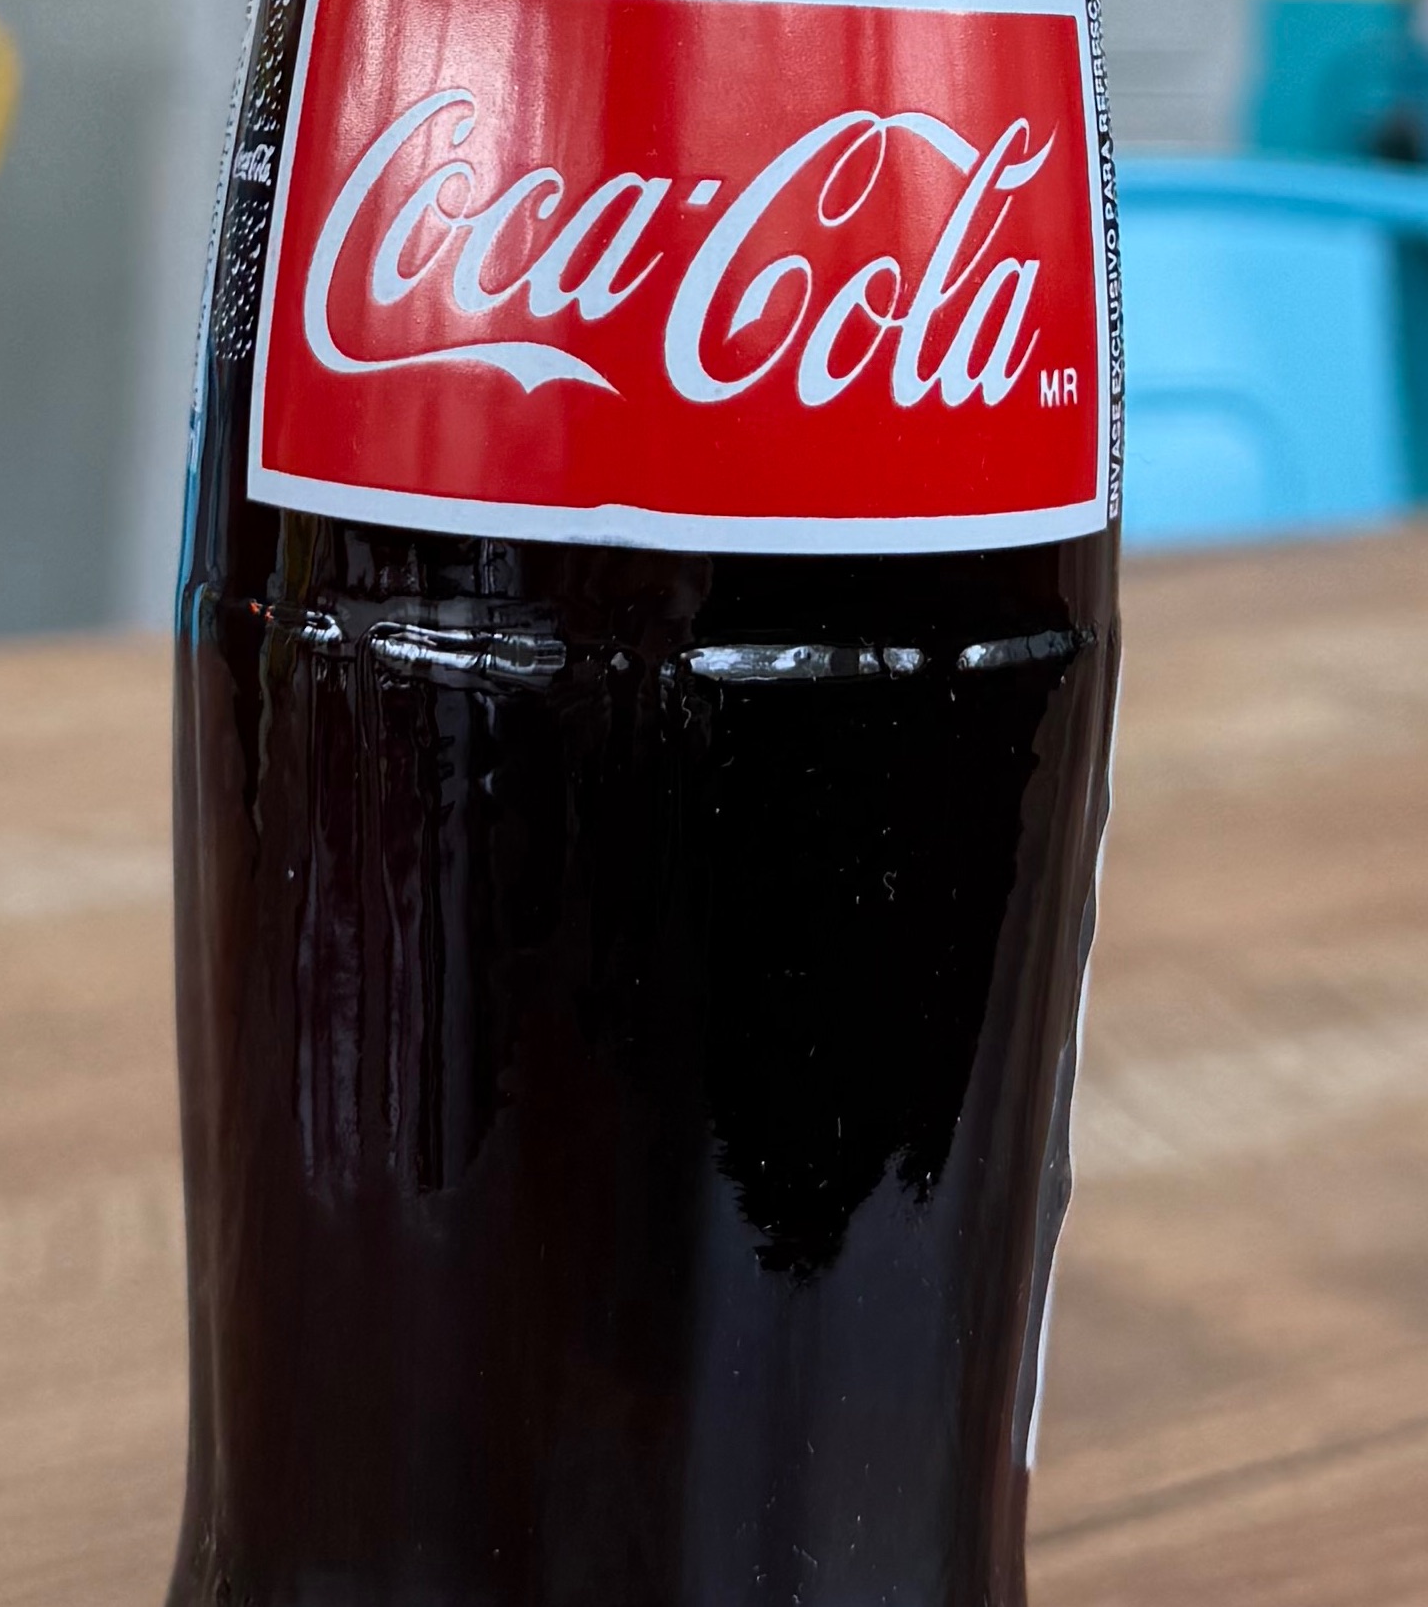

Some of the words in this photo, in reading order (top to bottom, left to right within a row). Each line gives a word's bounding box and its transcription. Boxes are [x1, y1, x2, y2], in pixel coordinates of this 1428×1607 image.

[303, 88, 1059, 409] Coca-Cola
[1106, 228, 1124, 395] EXCLUSIVO
[1039, 367, 1078, 409] MR
[1108, 400, 1123, 520] ENVASE
